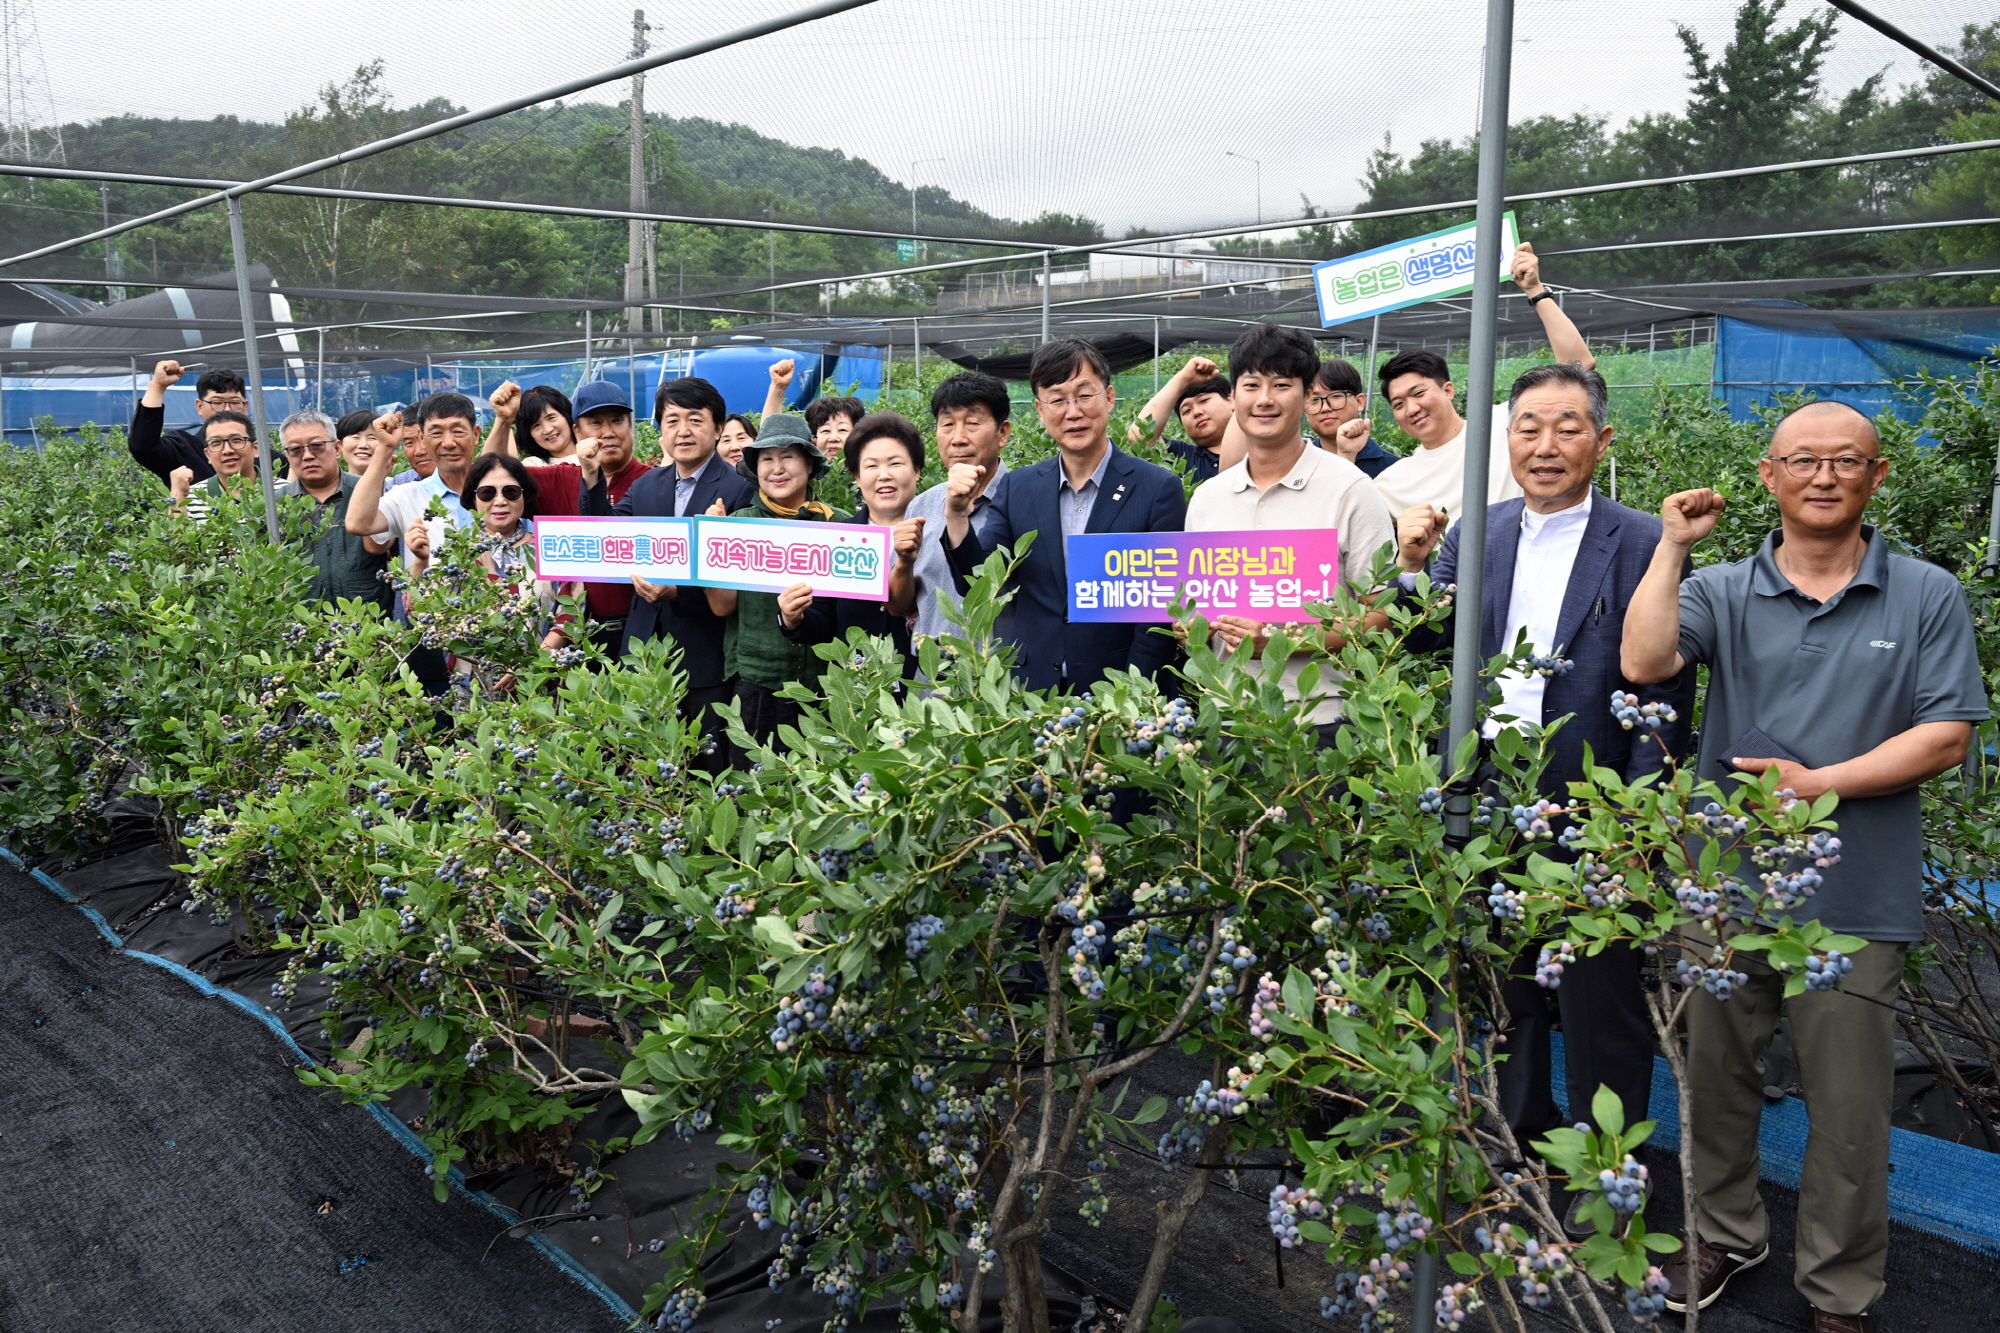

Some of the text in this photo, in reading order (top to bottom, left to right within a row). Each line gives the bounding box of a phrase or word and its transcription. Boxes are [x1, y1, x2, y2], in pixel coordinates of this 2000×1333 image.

[1332, 240, 1504, 305] 농업은 생명산
[541, 535, 602, 562] 탄소중립
[707, 537, 879, 580] 지속가능 도시 안산
[1104, 546, 1297, 577] 이민근 시장님과
[1075, 579, 1176, 609] 함께하는
[1185, 578, 1239, 608] 안산
